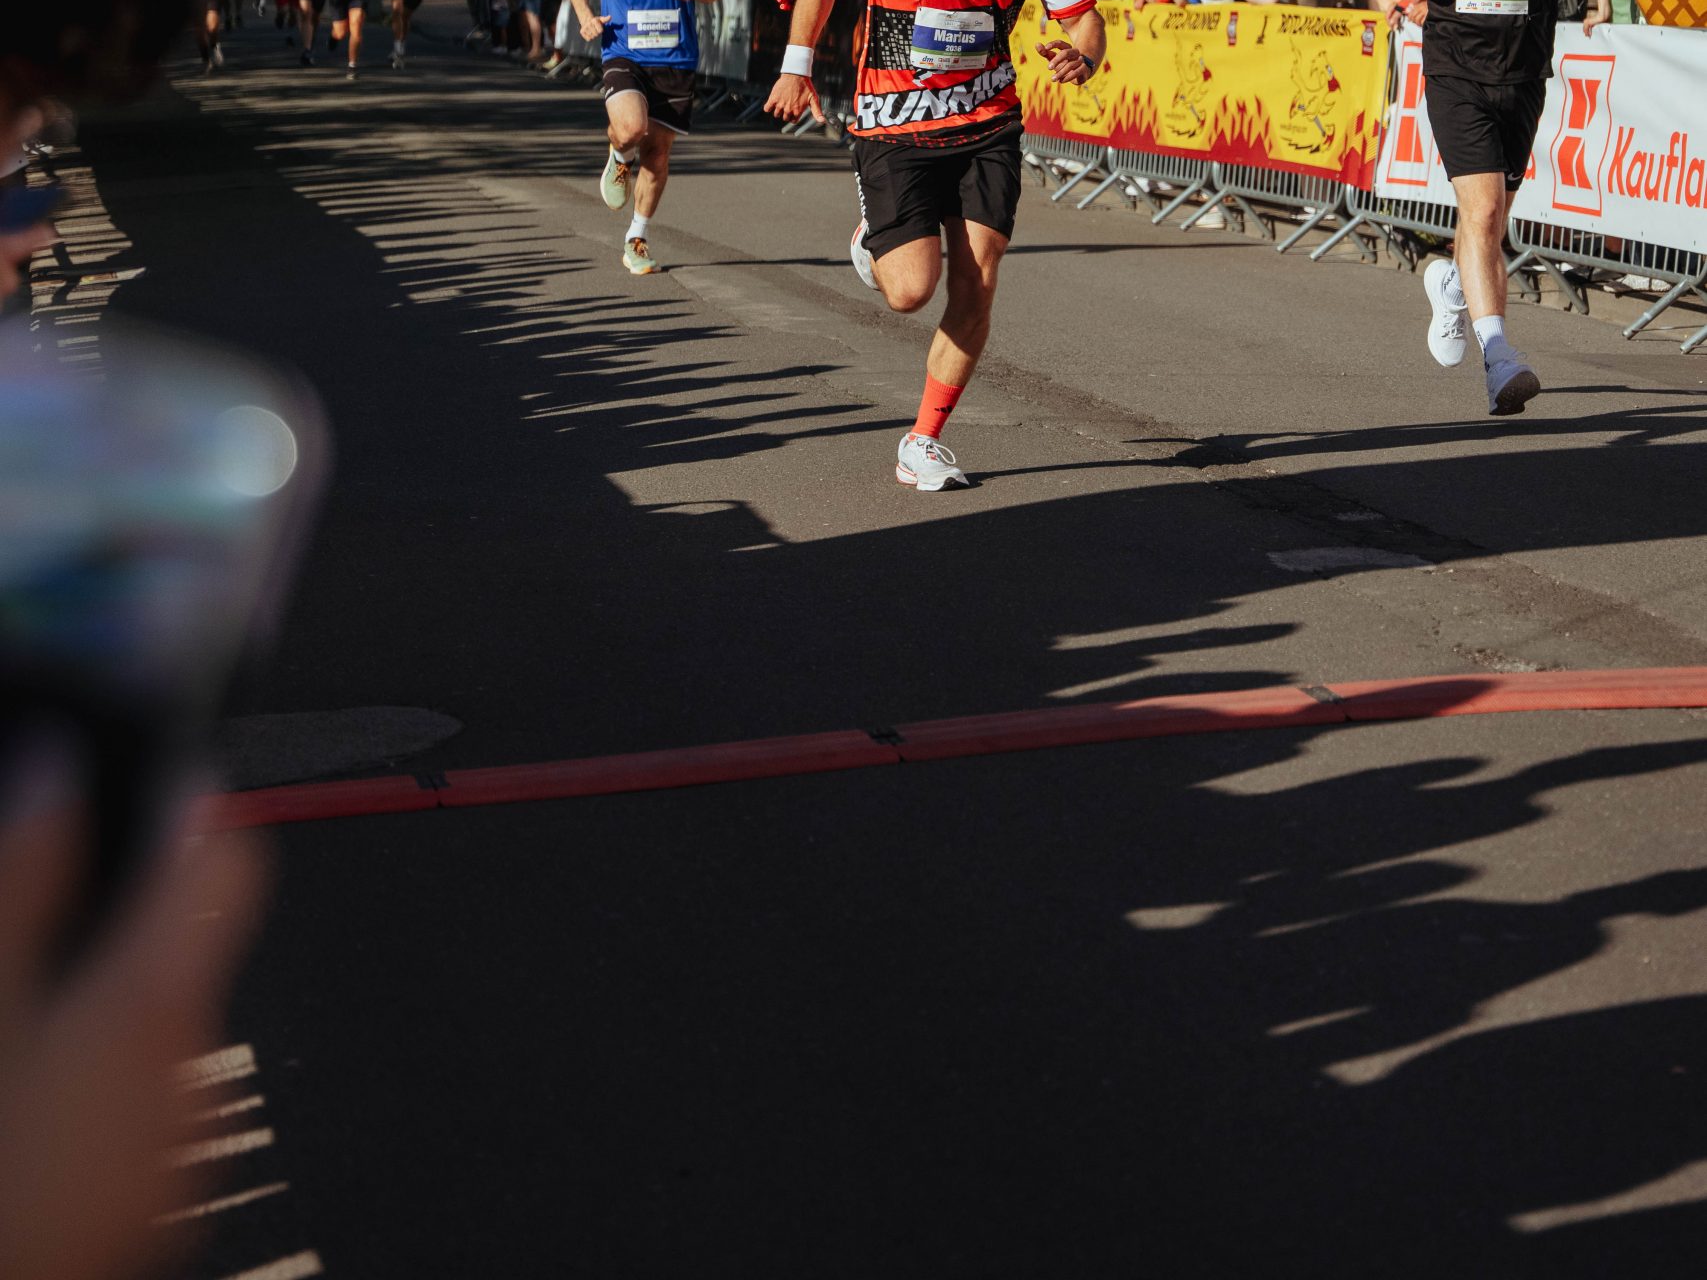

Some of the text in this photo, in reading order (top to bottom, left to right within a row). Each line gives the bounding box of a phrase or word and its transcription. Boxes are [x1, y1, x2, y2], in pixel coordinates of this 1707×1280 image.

[637, 22, 671, 31] Benedict
[934, 29, 976, 44] Marius
[1607, 126, 1707, 209] Kaufla
